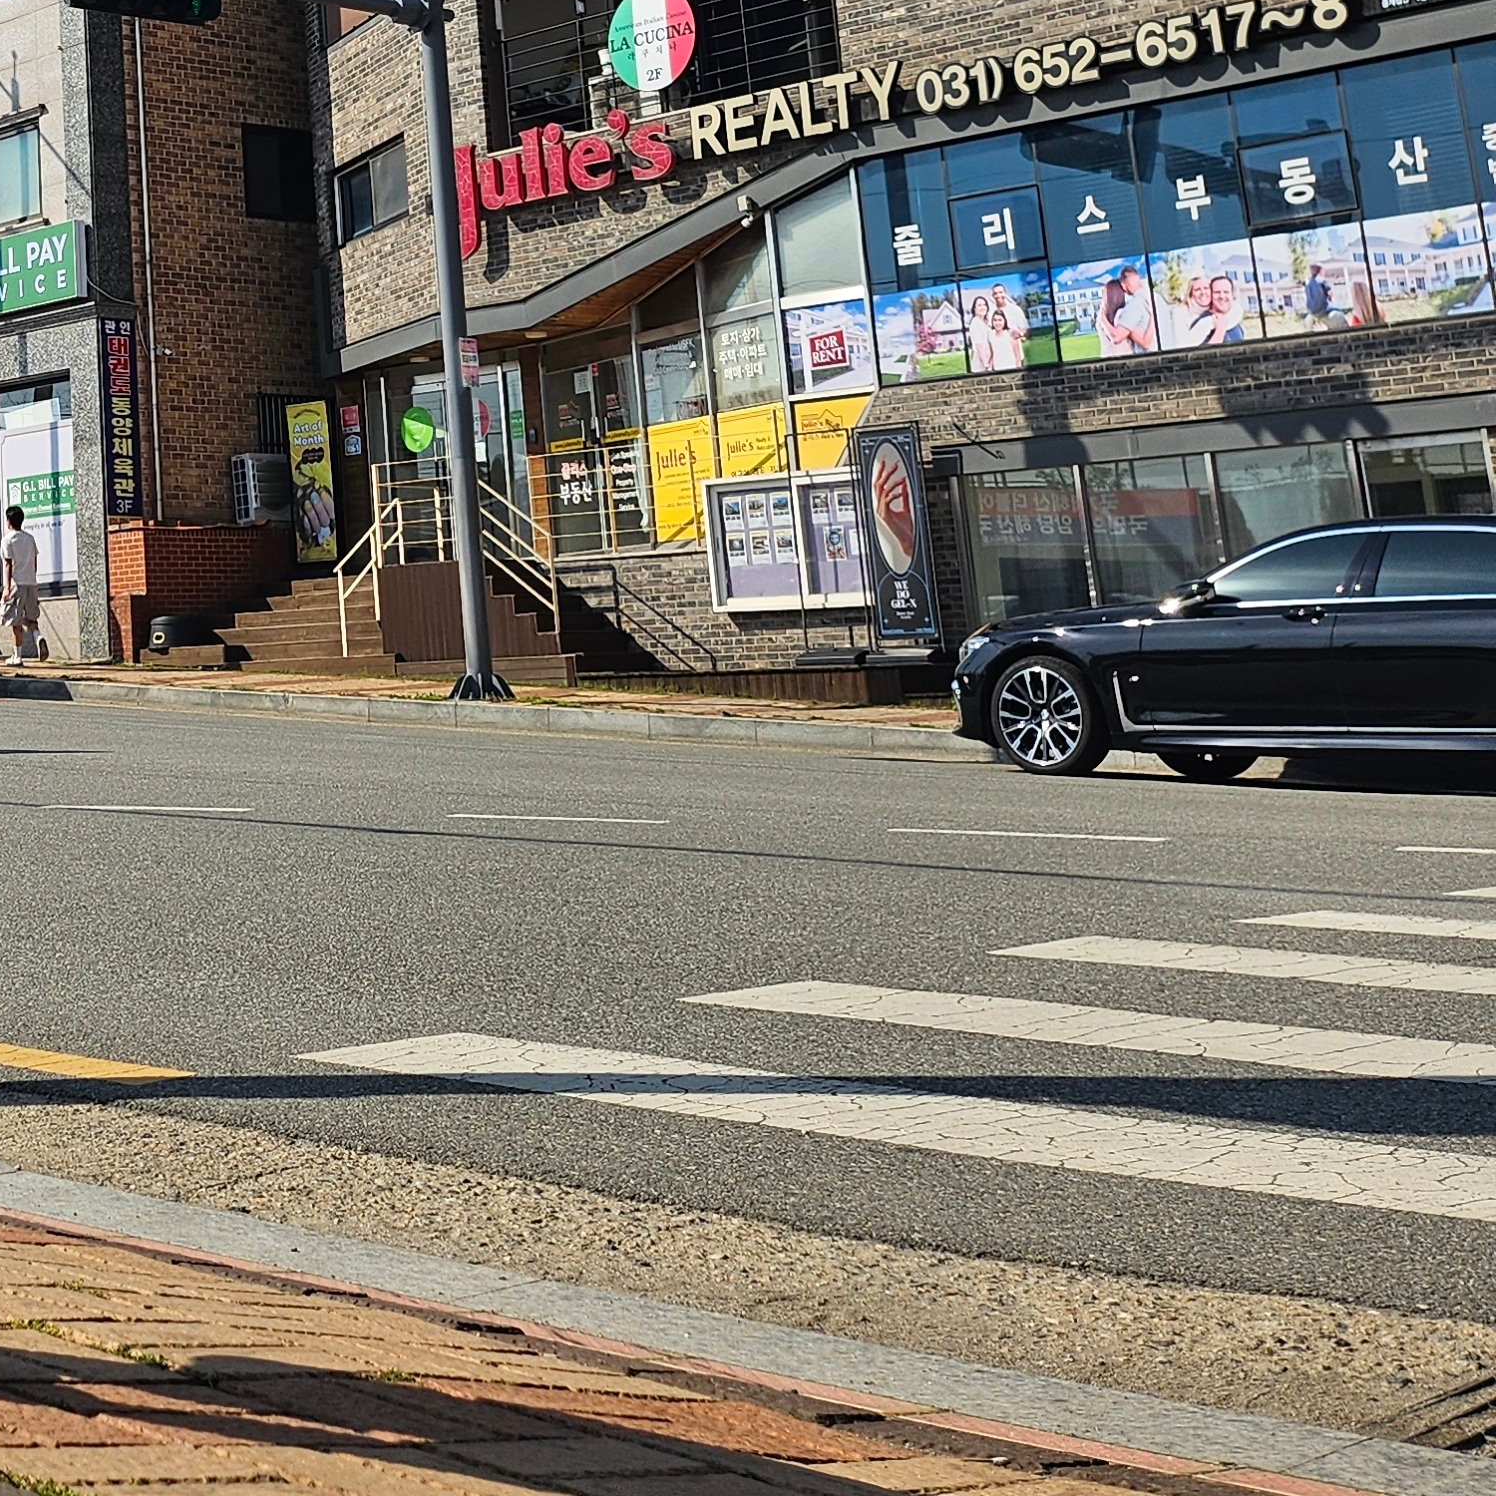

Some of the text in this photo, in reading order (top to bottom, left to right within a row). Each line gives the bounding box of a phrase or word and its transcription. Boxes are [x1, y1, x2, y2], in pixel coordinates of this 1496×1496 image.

[610, 21, 694, 53] LA CUCINA
[646, 68, 663, 82] 2F
[454, 61, 904, 262] Julie's REALTY
[27, 233, 68, 269] PAY
[815, 335, 839, 350] FOR
[812, 346, 846, 365] RENT
[293, 420, 323, 434] Art of
[293, 433, 325, 447] Month
[727, 439, 754, 461] Julie's
[38, 478, 56, 491] BILL
[58, 474, 74, 487] PAY
[560, 481, 593, 506] 부동산
[116, 499, 133, 513] 3F
[894, 580, 909, 590] WE
[896, 590, 910, 599] DO
